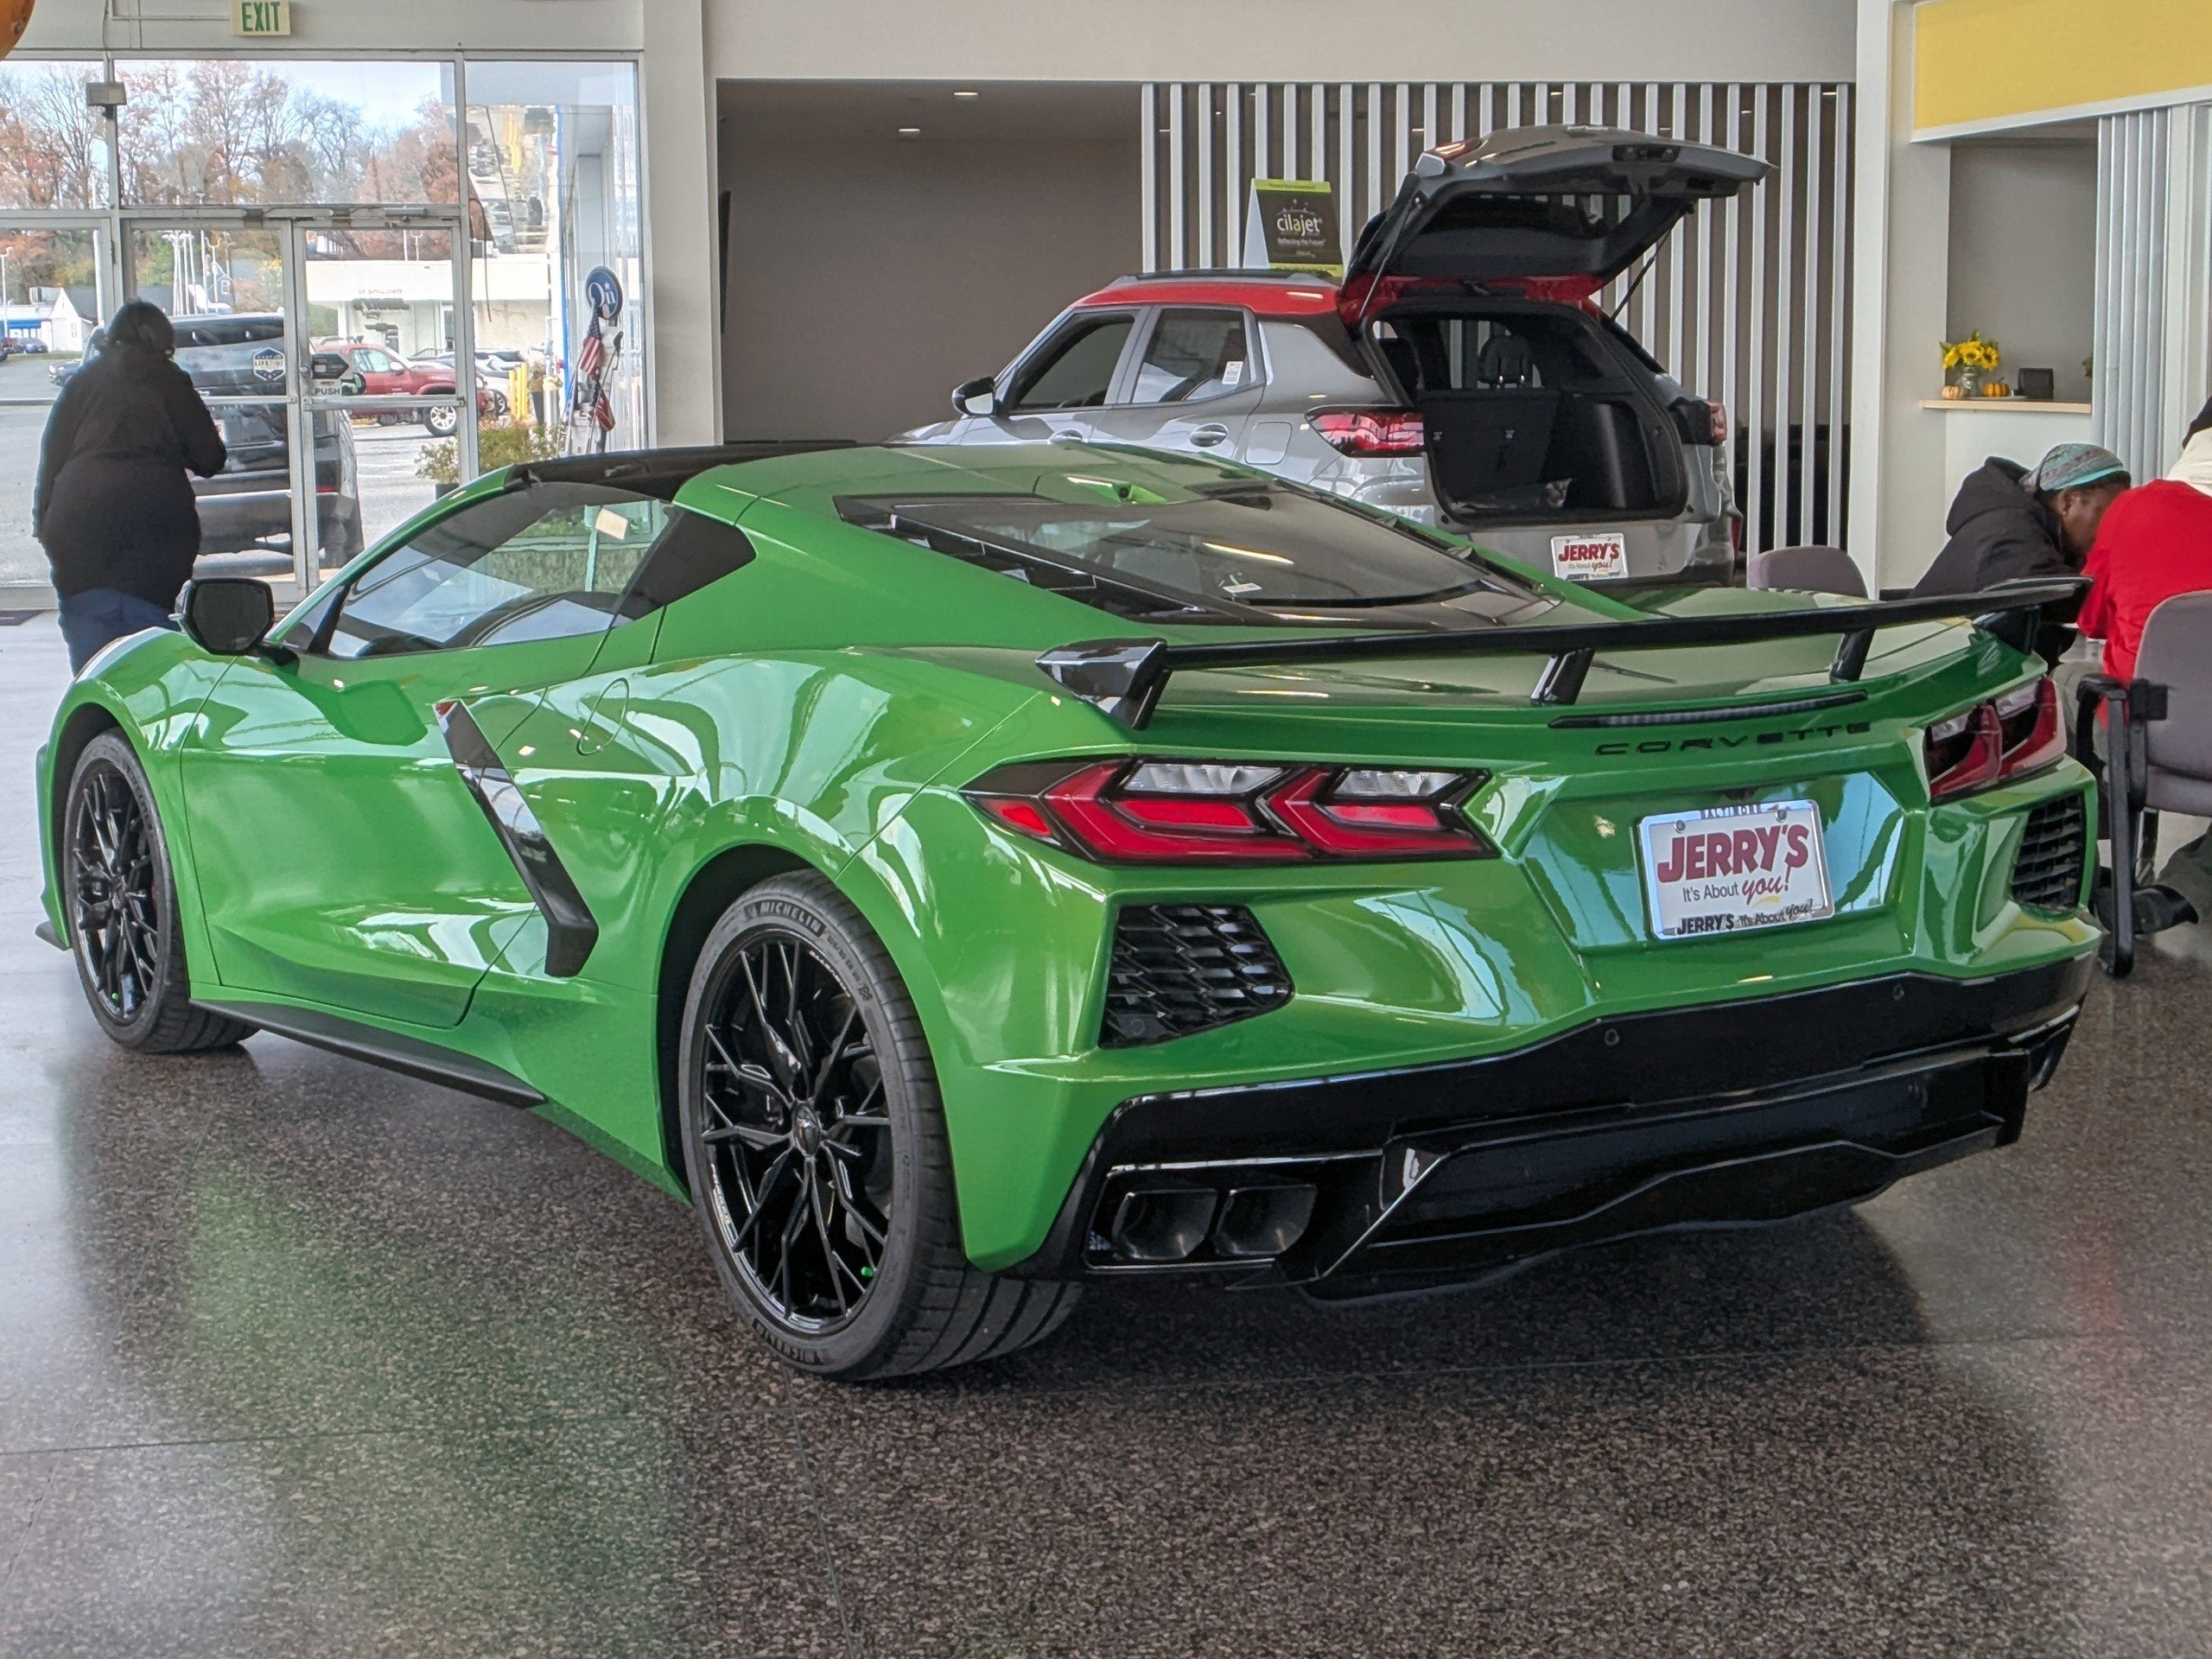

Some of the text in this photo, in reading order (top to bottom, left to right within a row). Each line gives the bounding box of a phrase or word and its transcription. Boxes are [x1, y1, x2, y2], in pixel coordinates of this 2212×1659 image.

[242, 2, 280, 31] EXIT
[1277, 214, 1320, 236] cilajet
[1559, 543, 1619, 562] JERRY'S
[1595, 722, 1870, 755] CORVETTE
[1657, 824, 1809, 883] JERRY'S
[1682, 866, 1791, 906] It's About you!
[760, 901, 822, 933] MICHELIN
[1677, 913, 1734, 935] JERRY'S
[1754, 911, 1784, 925] About
